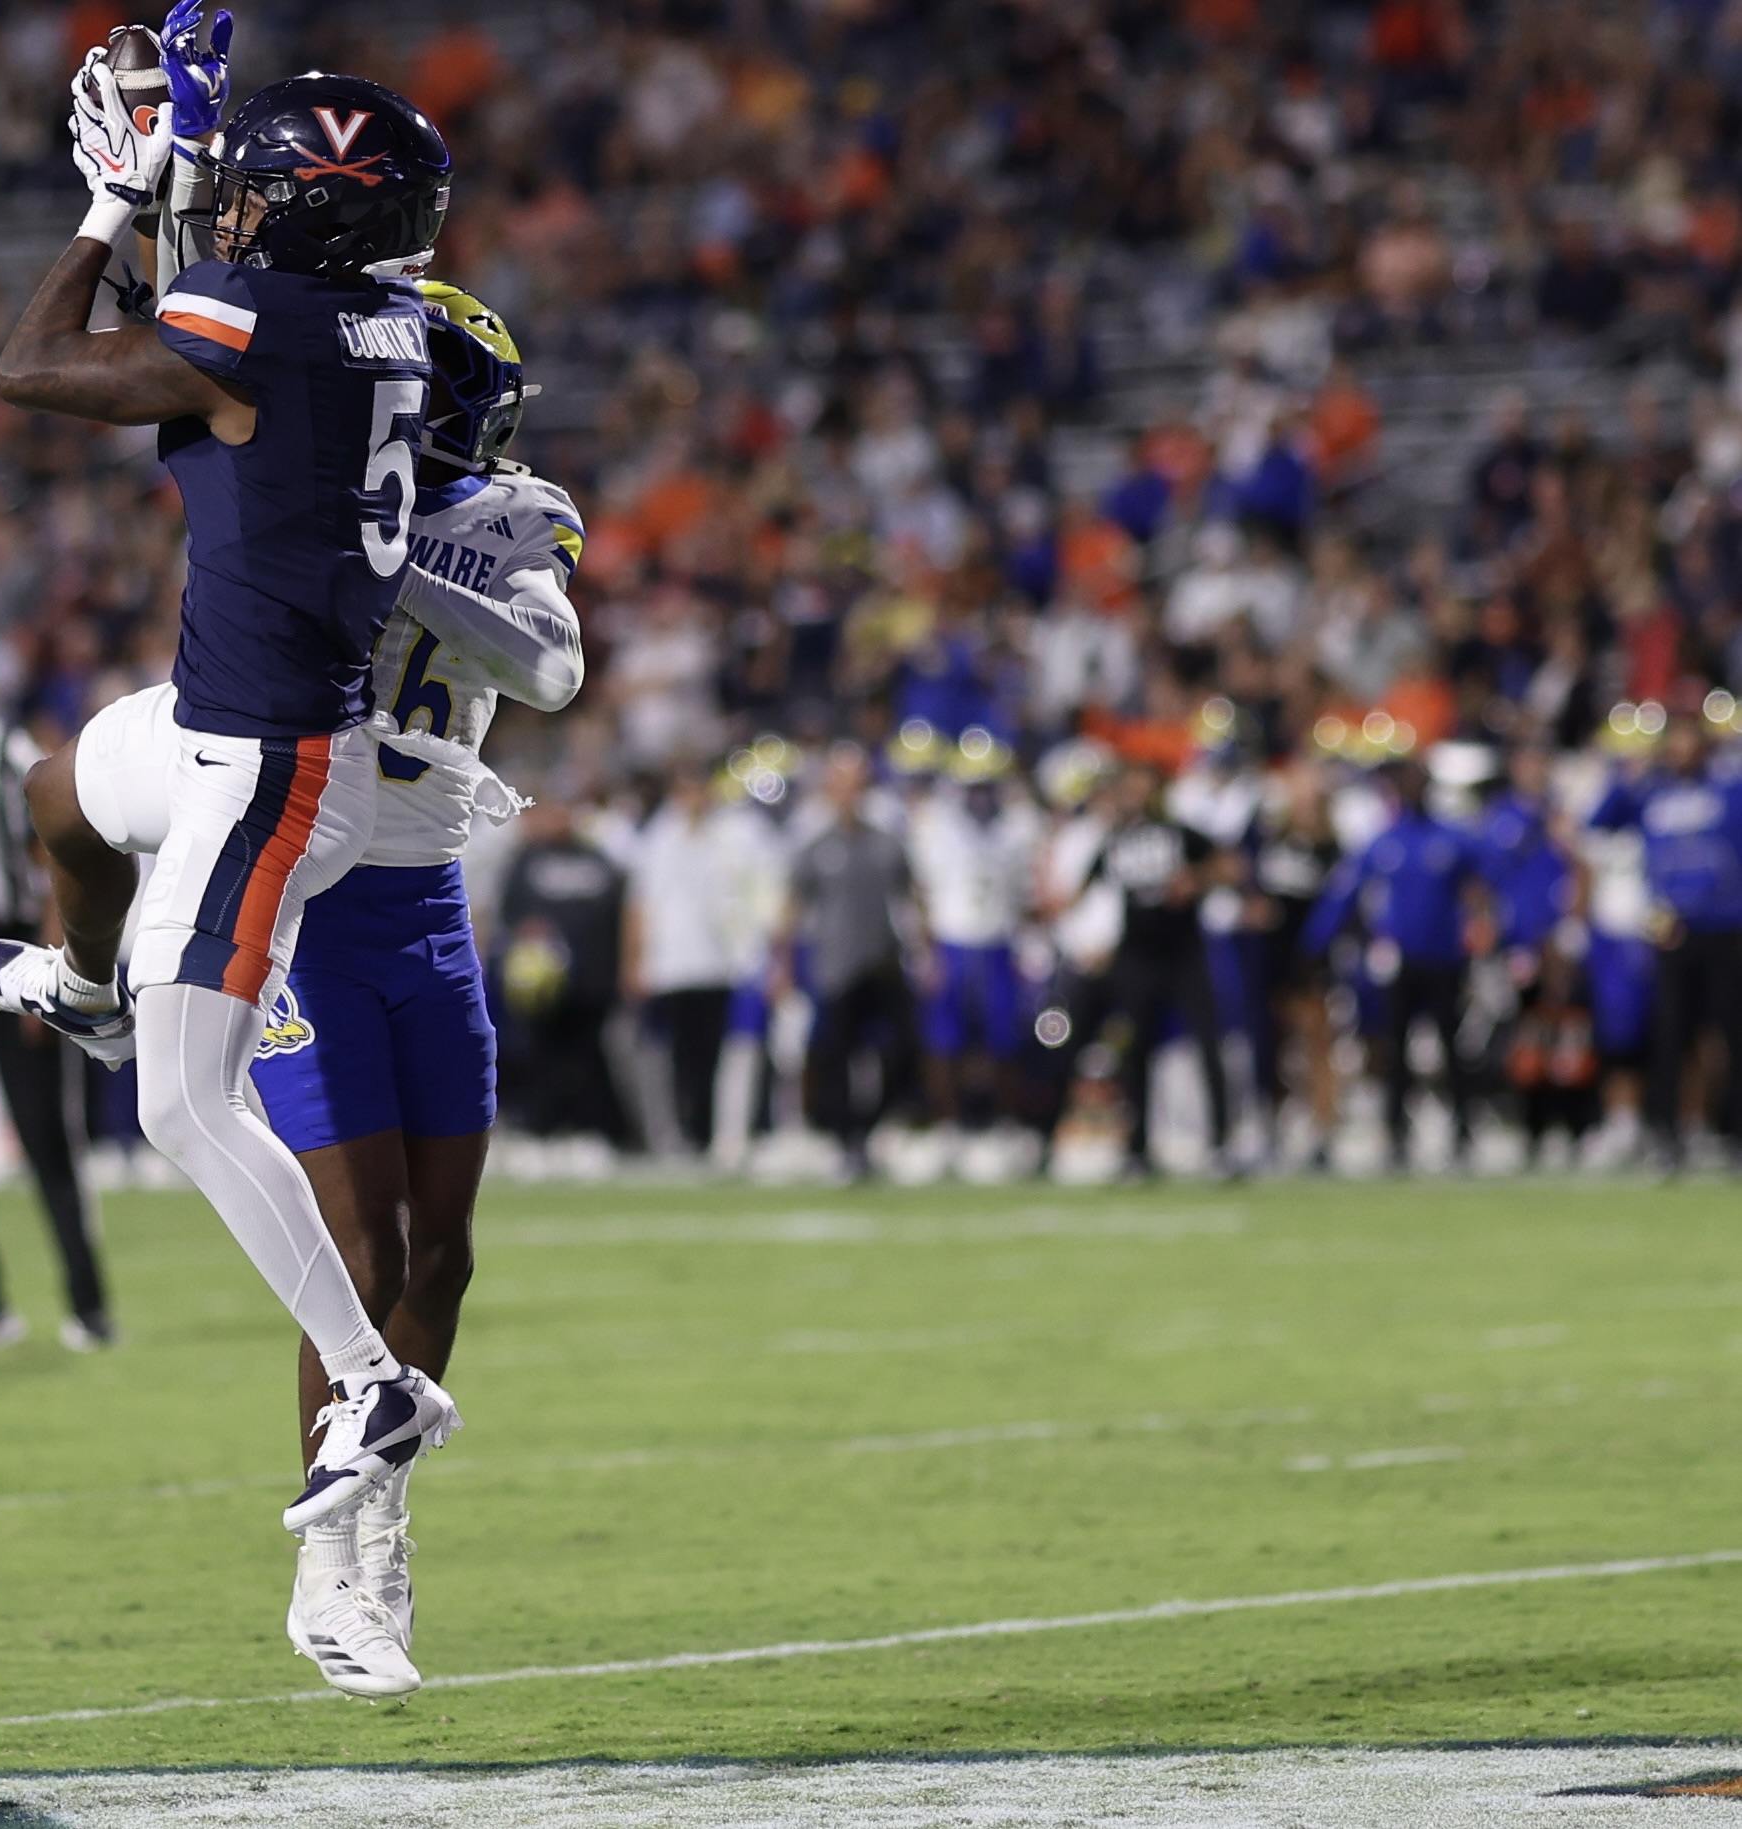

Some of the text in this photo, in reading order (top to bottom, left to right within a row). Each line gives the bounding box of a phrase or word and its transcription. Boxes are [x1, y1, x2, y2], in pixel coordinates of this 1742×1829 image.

[311, 106, 375, 163] V
[338, 312, 427, 363] COURTNEY
[360, 380, 416, 578] 5
[377, 624, 455, 784] 6
